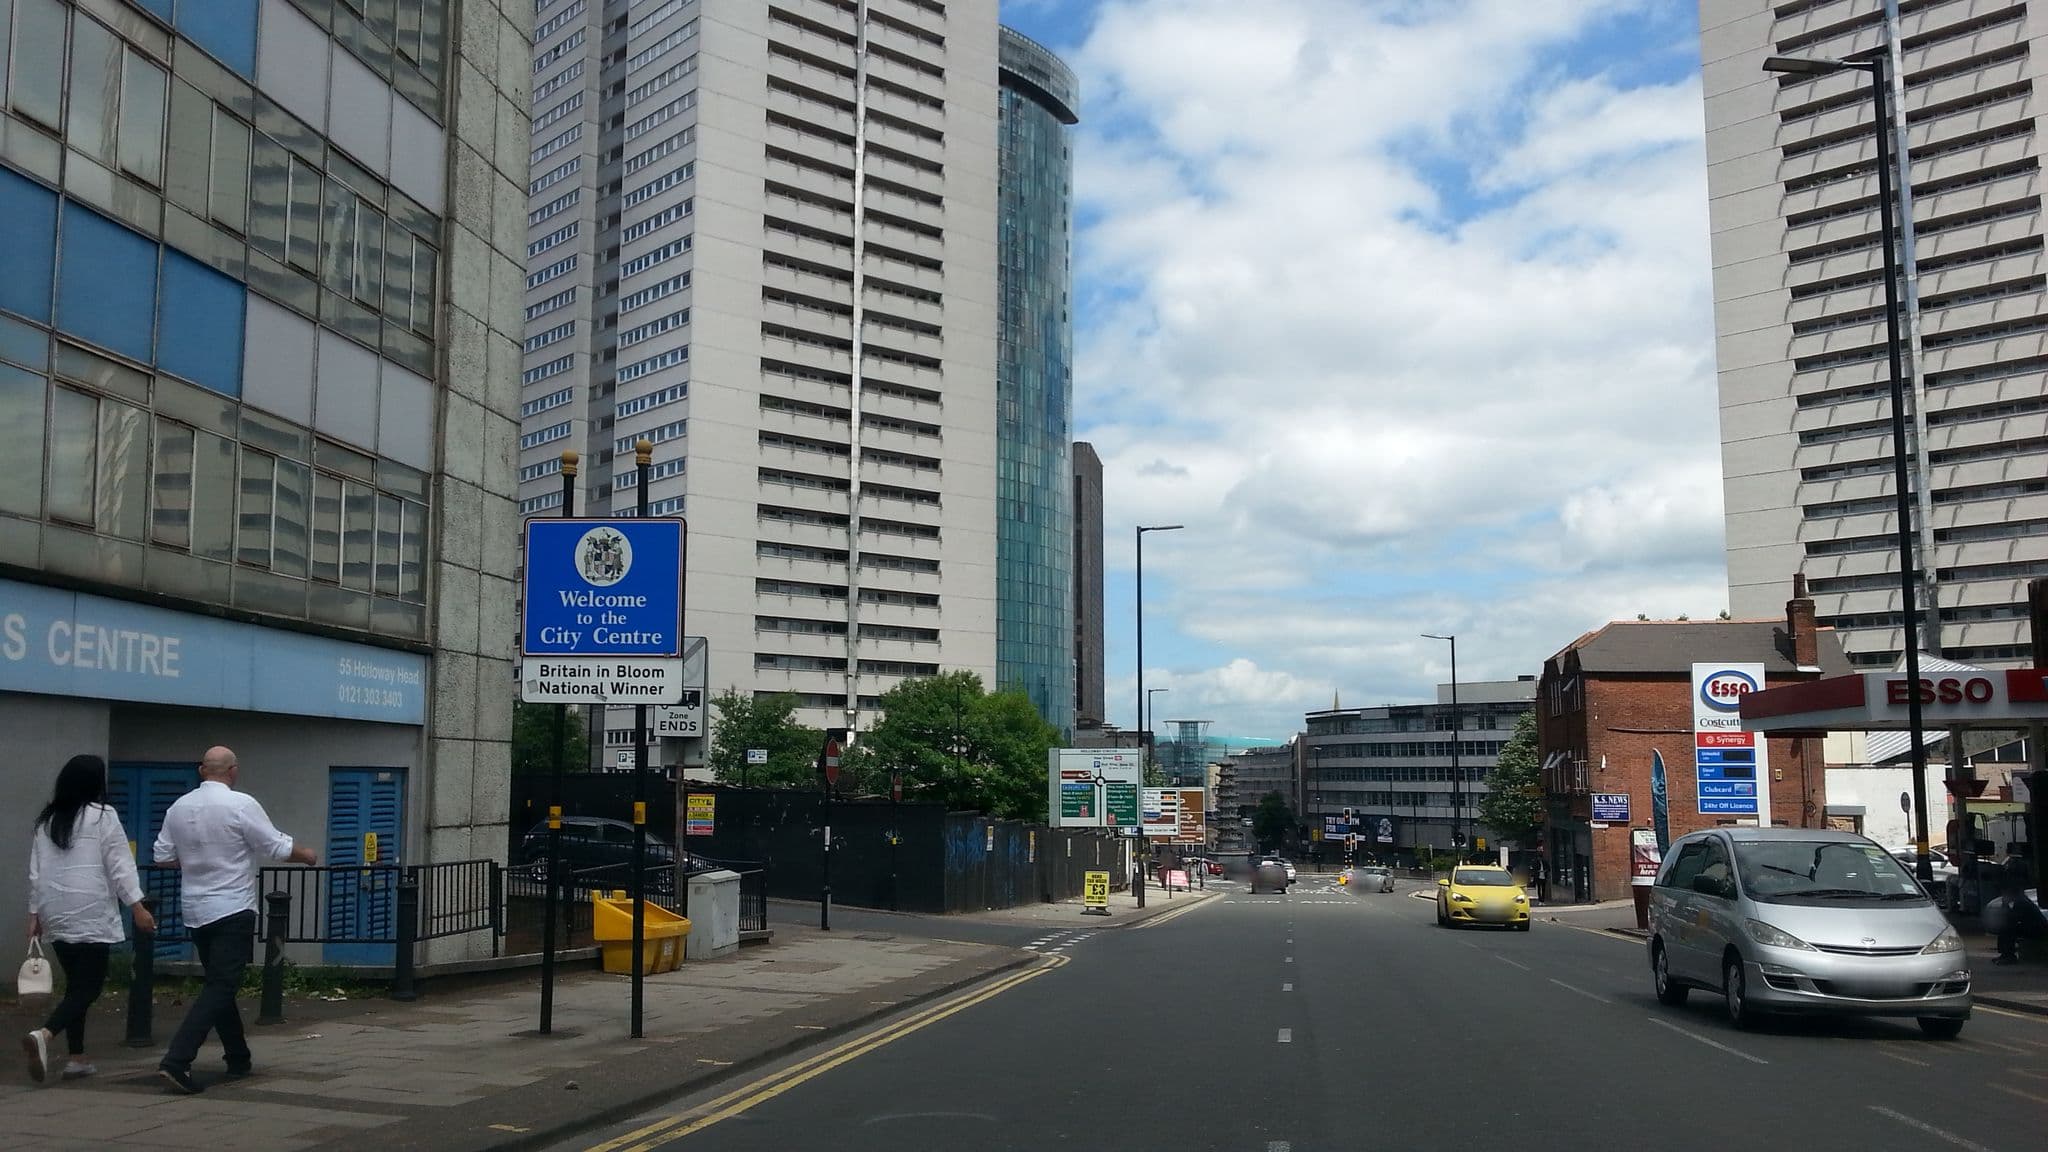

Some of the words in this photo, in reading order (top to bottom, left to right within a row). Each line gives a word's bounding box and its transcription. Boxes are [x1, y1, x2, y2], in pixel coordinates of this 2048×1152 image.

[559, 590, 647, 608] Welcome
[577, 613, 593, 625] to
[601, 610, 627, 625] the
[540, 627, 582, 650] City
[593, 627, 663, 645] Centre
[48, 620, 181, 677] CENTRE
[339, 657, 352, 676] 55
[354, 660, 396, 685] Holloway
[398, 667, 420, 684] Head
[540, 664, 591, 678] Britain
[597, 664, 610, 678] in
[616, 664, 665, 679] Bloom
[339, 684, 361, 704] 0121
[363, 687, 382, 705] 303
[539, 680, 605, 696] National
[611, 681, 665, 696] Winner
[1711, 680, 1750, 698] Esso
[1886, 677, 1994, 706] ESSO
[669, 711, 689, 720] Zone
[1699, 715, 1740, 729] Costcutt
[659, 720, 698, 732] ENDS
[1716, 735, 1746, 745] Synergy
[1594, 795, 1607, 804] K.S.
[1608, 795, 1628, 805] NEWS
[1326, 825, 1336, 833] FOR
[1092, 884, 1105, 895] £3
